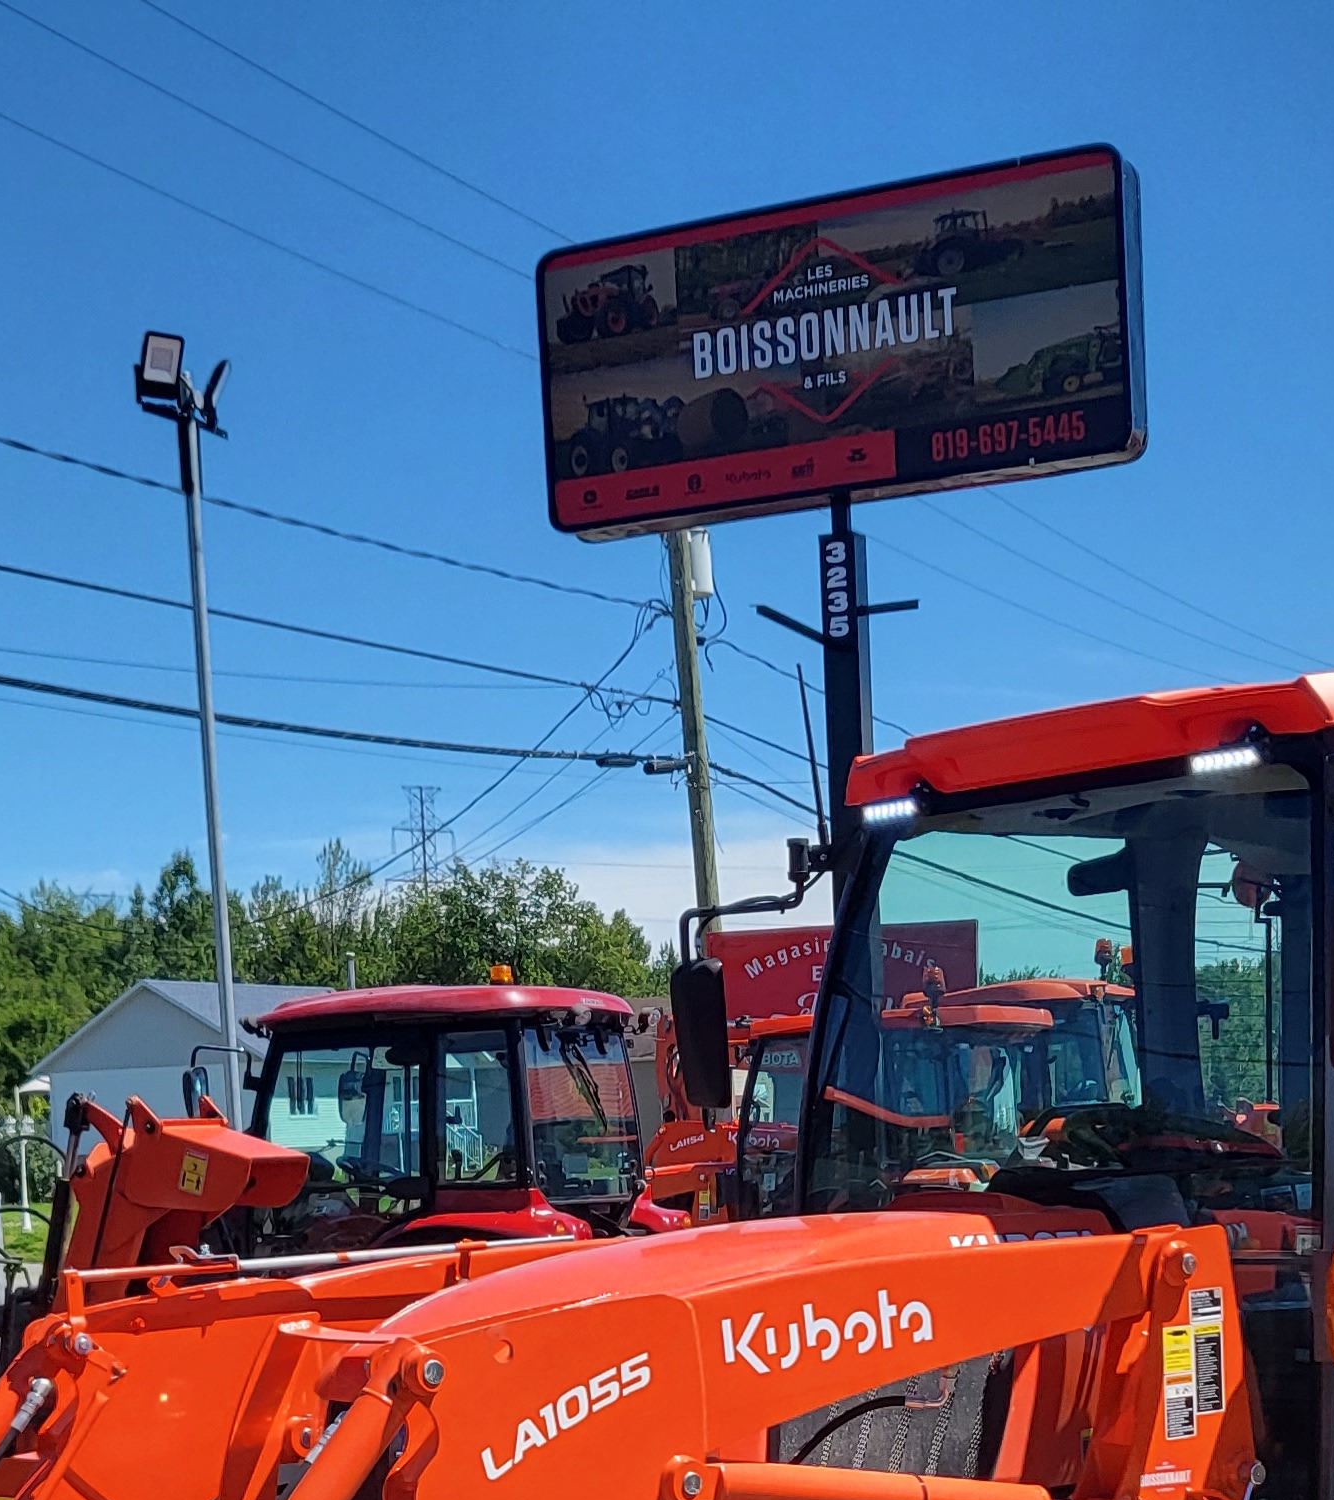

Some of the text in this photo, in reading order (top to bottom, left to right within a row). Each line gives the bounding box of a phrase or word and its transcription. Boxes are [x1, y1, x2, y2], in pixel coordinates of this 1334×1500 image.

[807, 264, 833, 281] LES
[773, 274, 869, 304] MACHINERIES
[692, 286, 958, 380] BOISSONNAULT
[803, 370, 847, 389] & FILS
[931, 409, 1086, 462] 819-697-5445
[825, 541, 849, 638] 3235
[880, 941, 937, 968] abais
[744, 1051, 800, 1067] BOTA
[728, 1131, 780, 1149] Kbota
[721, 1289, 933, 1374] Kubota
[480, 1352, 652, 1482] LA1055
